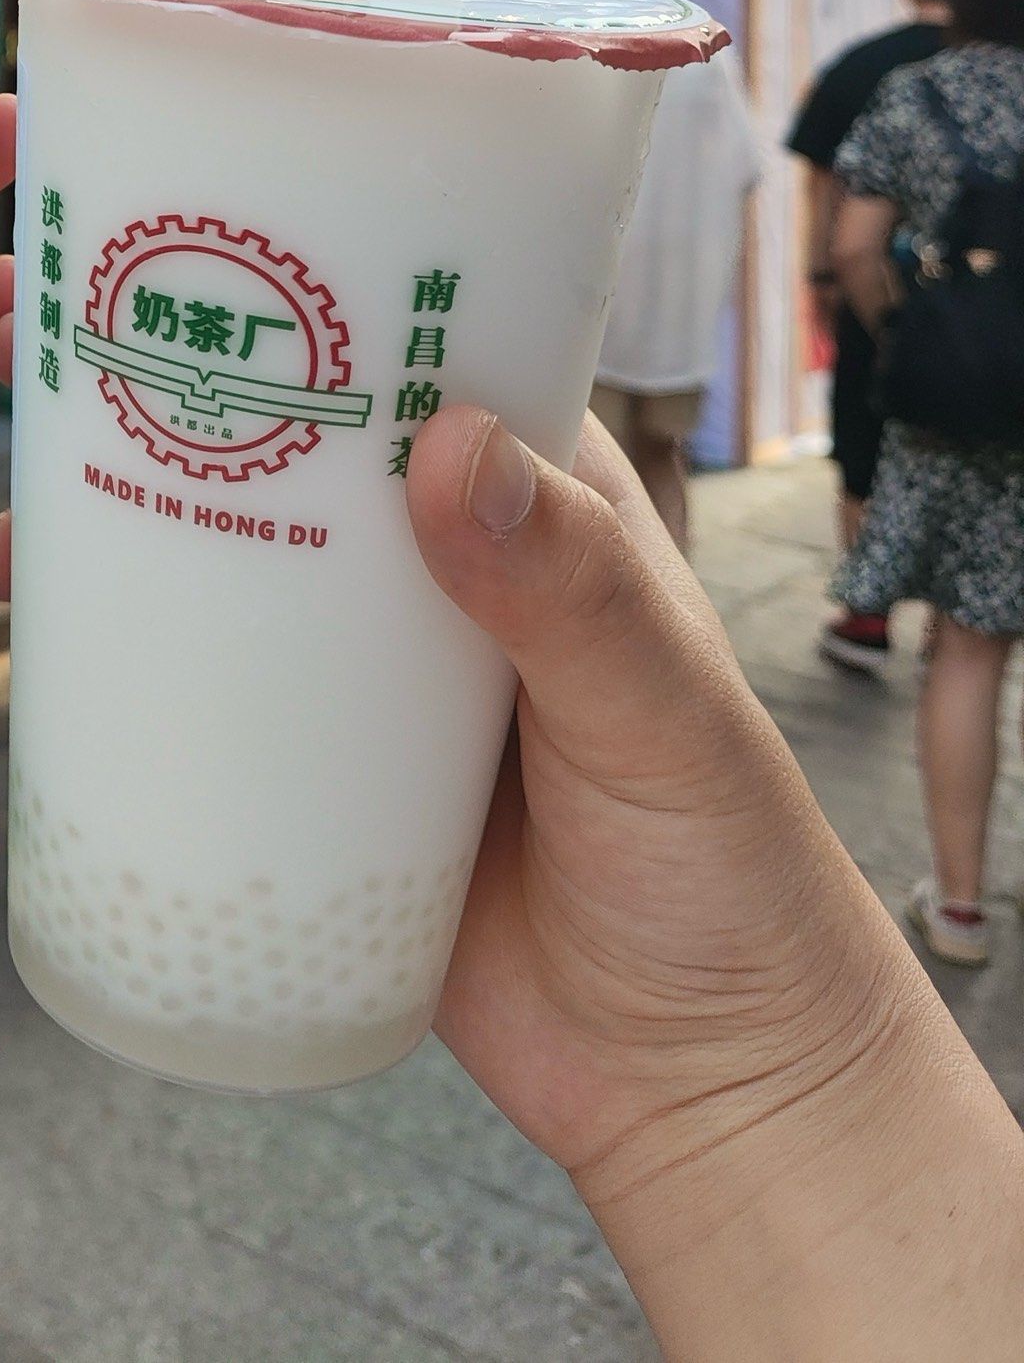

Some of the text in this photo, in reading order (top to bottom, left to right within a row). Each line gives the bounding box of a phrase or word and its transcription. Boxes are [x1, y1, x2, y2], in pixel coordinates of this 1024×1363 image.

[38, 185, 66, 394] 洪都制造
[131, 285, 297, 362] 奶茶厂
[84, 462, 328, 549] MADE IN HONG DU
